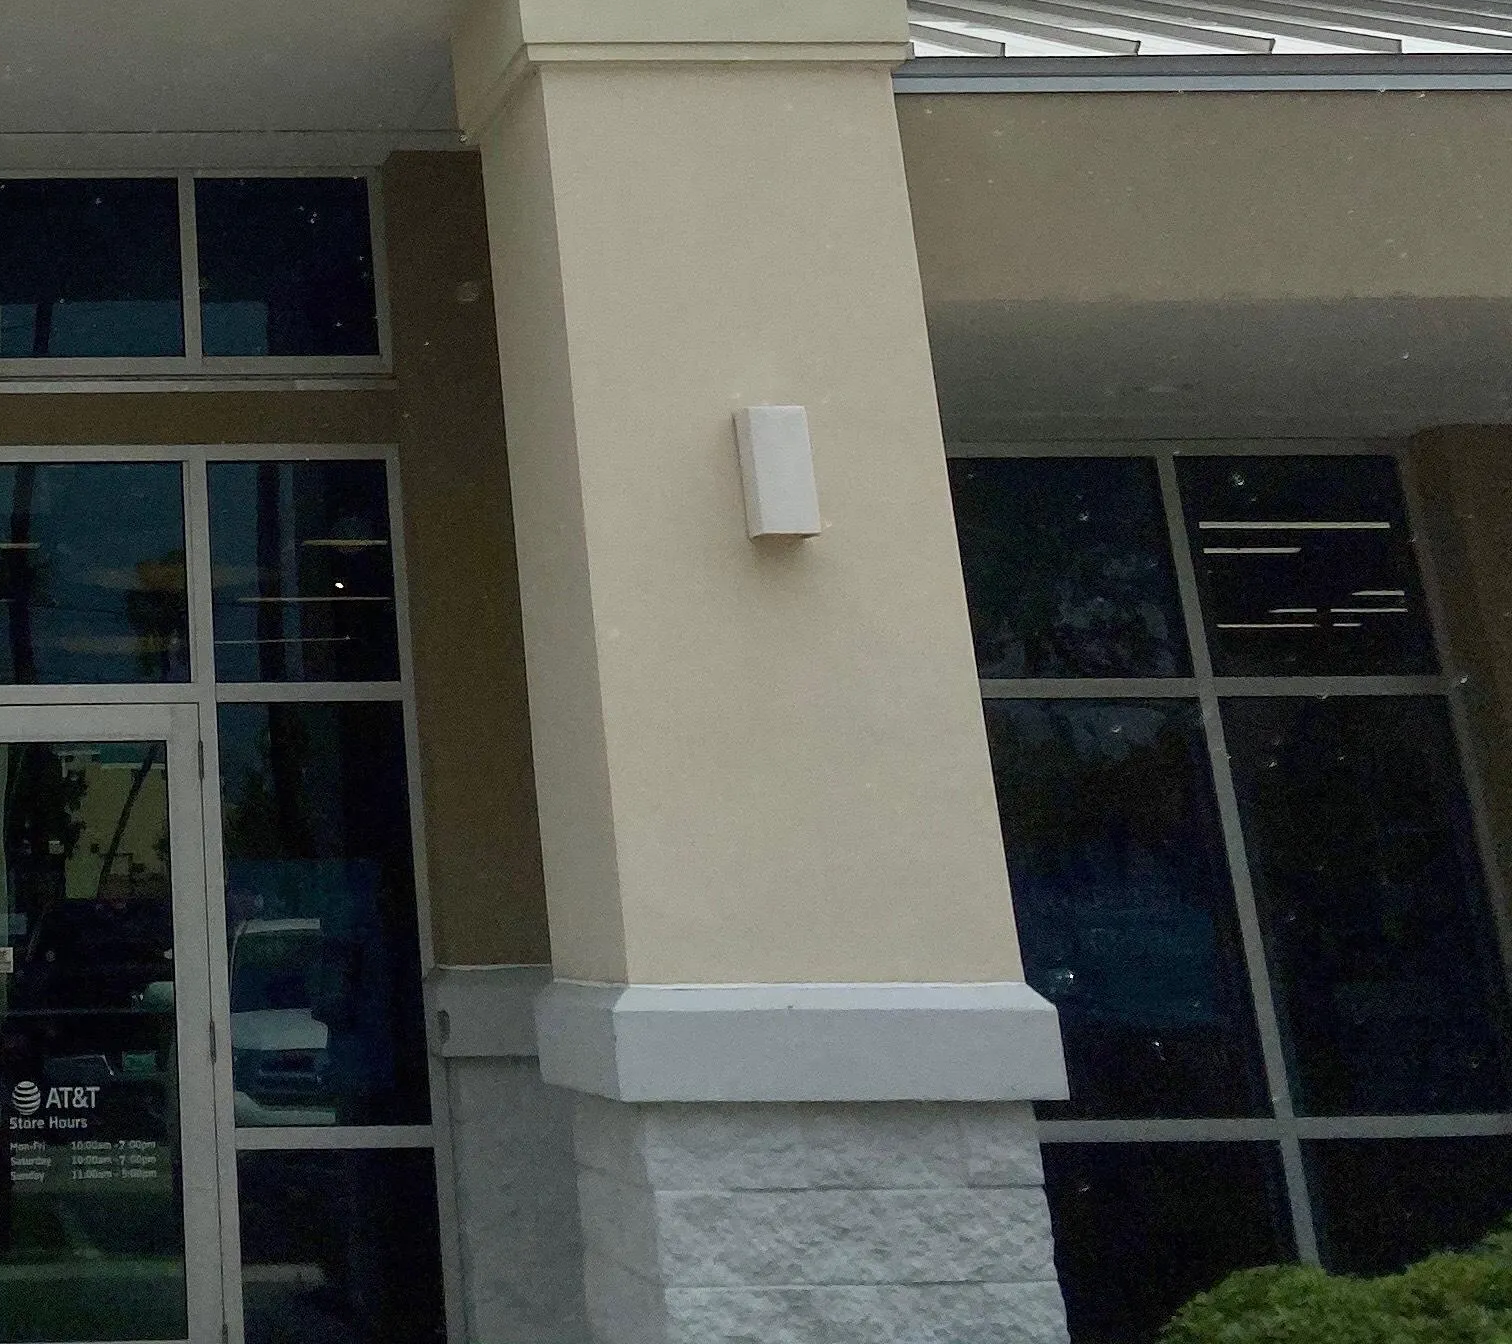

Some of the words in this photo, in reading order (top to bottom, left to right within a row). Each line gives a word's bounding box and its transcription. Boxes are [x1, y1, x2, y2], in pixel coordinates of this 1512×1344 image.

[45, 1086, 101, 1109] AT&T
[9, 1116, 45, 1130] Store
[49, 1115, 88, 1129] Hours
